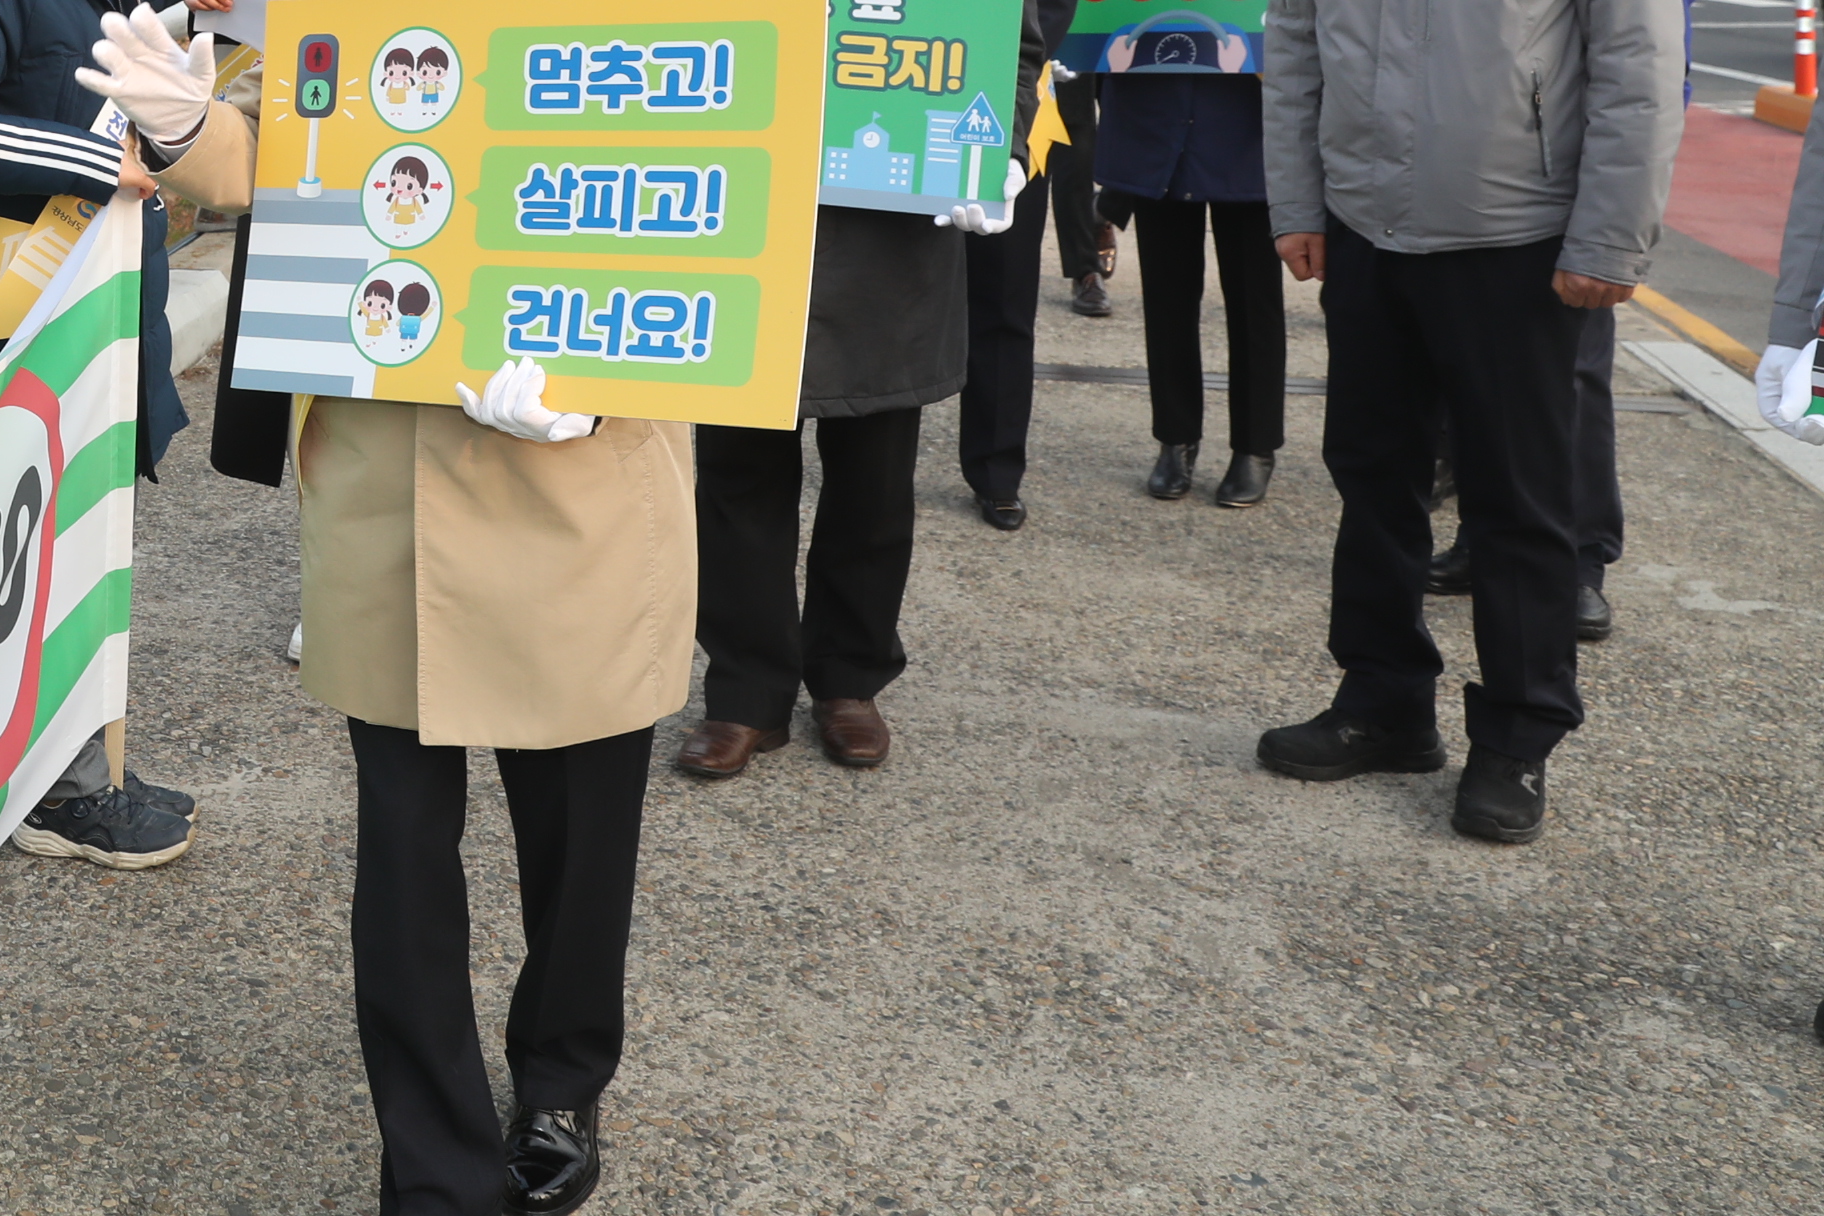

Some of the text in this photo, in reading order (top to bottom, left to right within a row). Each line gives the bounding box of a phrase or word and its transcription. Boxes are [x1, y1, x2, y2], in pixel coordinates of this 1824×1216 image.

[526, 37, 733, 113] 멈추고!
[835, 33, 965, 93] 금지!
[51, 205, 84, 233] 경상남도
[517, 160, 725, 236] 살피고!
[505, 284, 713, 364] 건너요!
